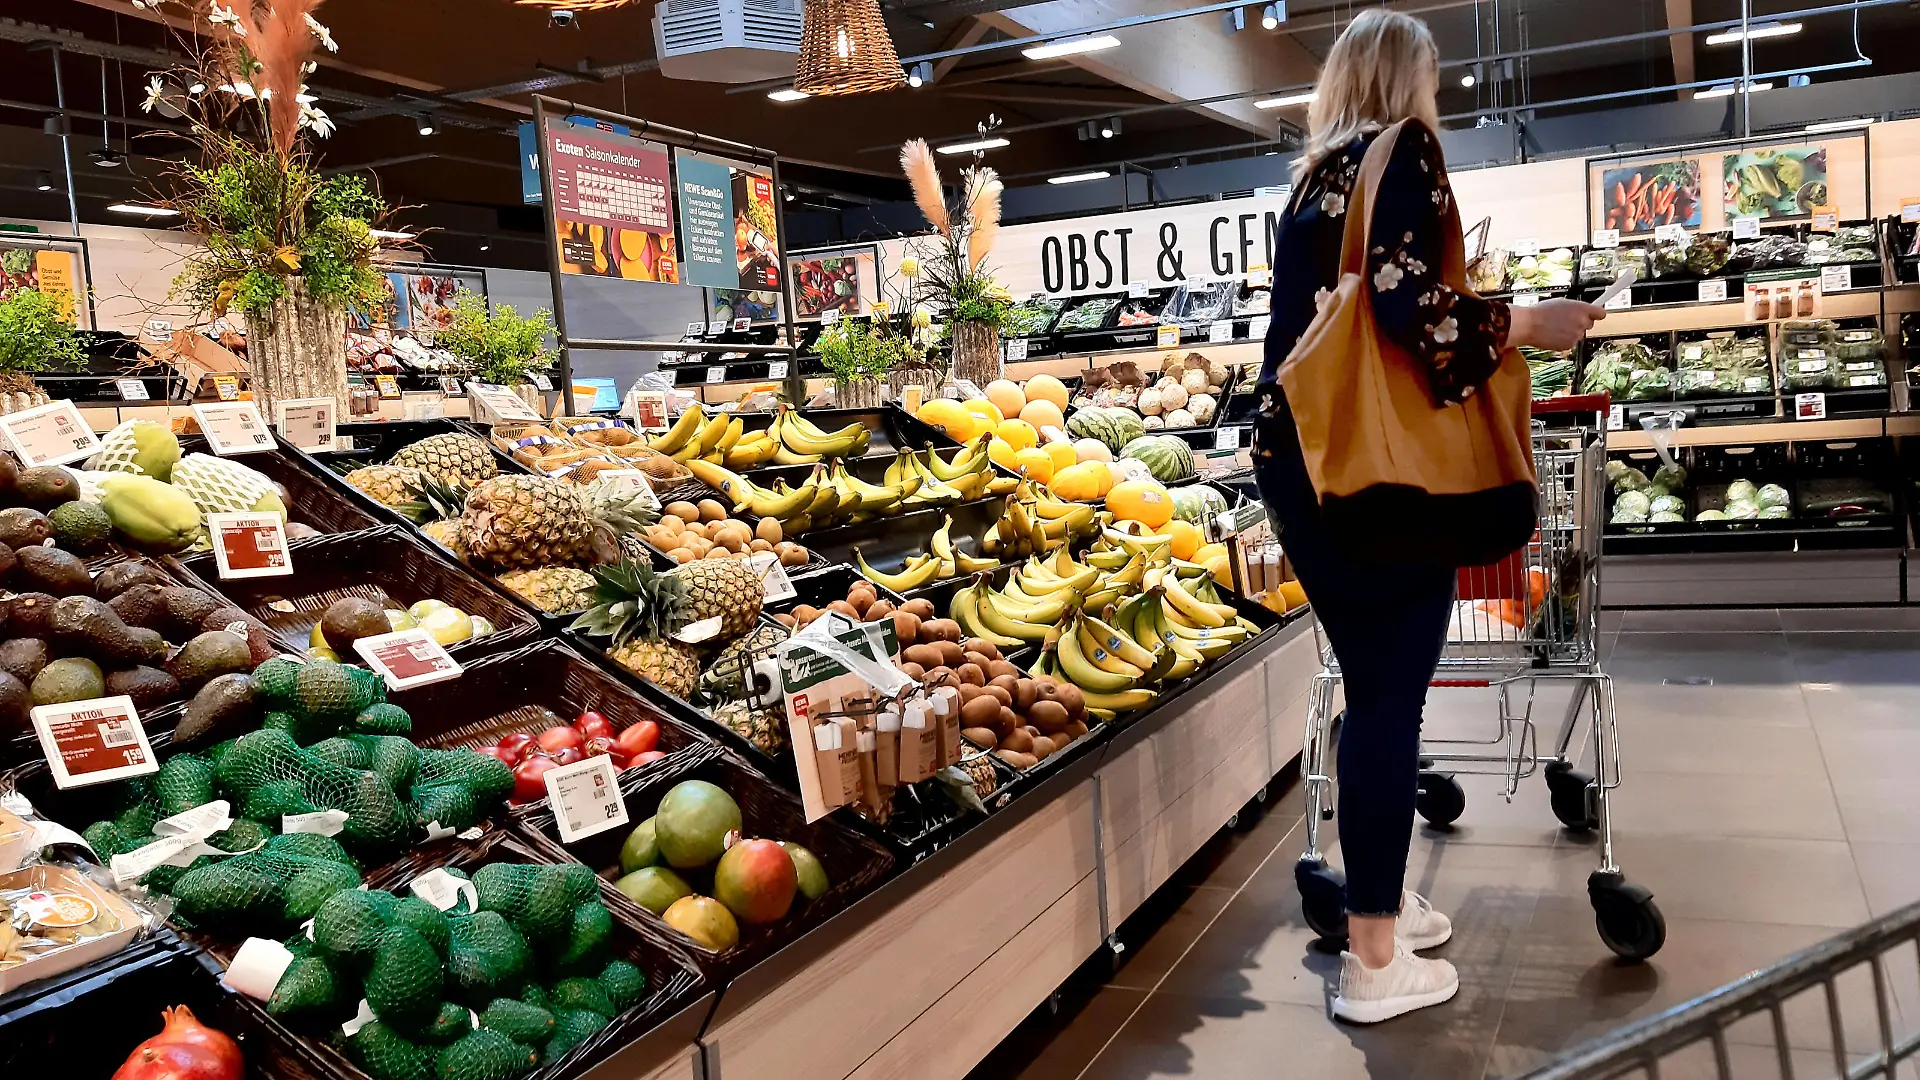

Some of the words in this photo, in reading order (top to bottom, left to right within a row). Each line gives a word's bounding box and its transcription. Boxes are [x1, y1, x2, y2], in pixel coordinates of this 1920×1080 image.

[555, 138, 584, 156] Exoten
[585, 145, 641, 168] Saisonkalender
[684, 182, 700, 195] REWE
[1041, 227, 1133, 293] OBST
[1156, 222, 1186, 282] &
[70, 709, 104, 721] AKTION
